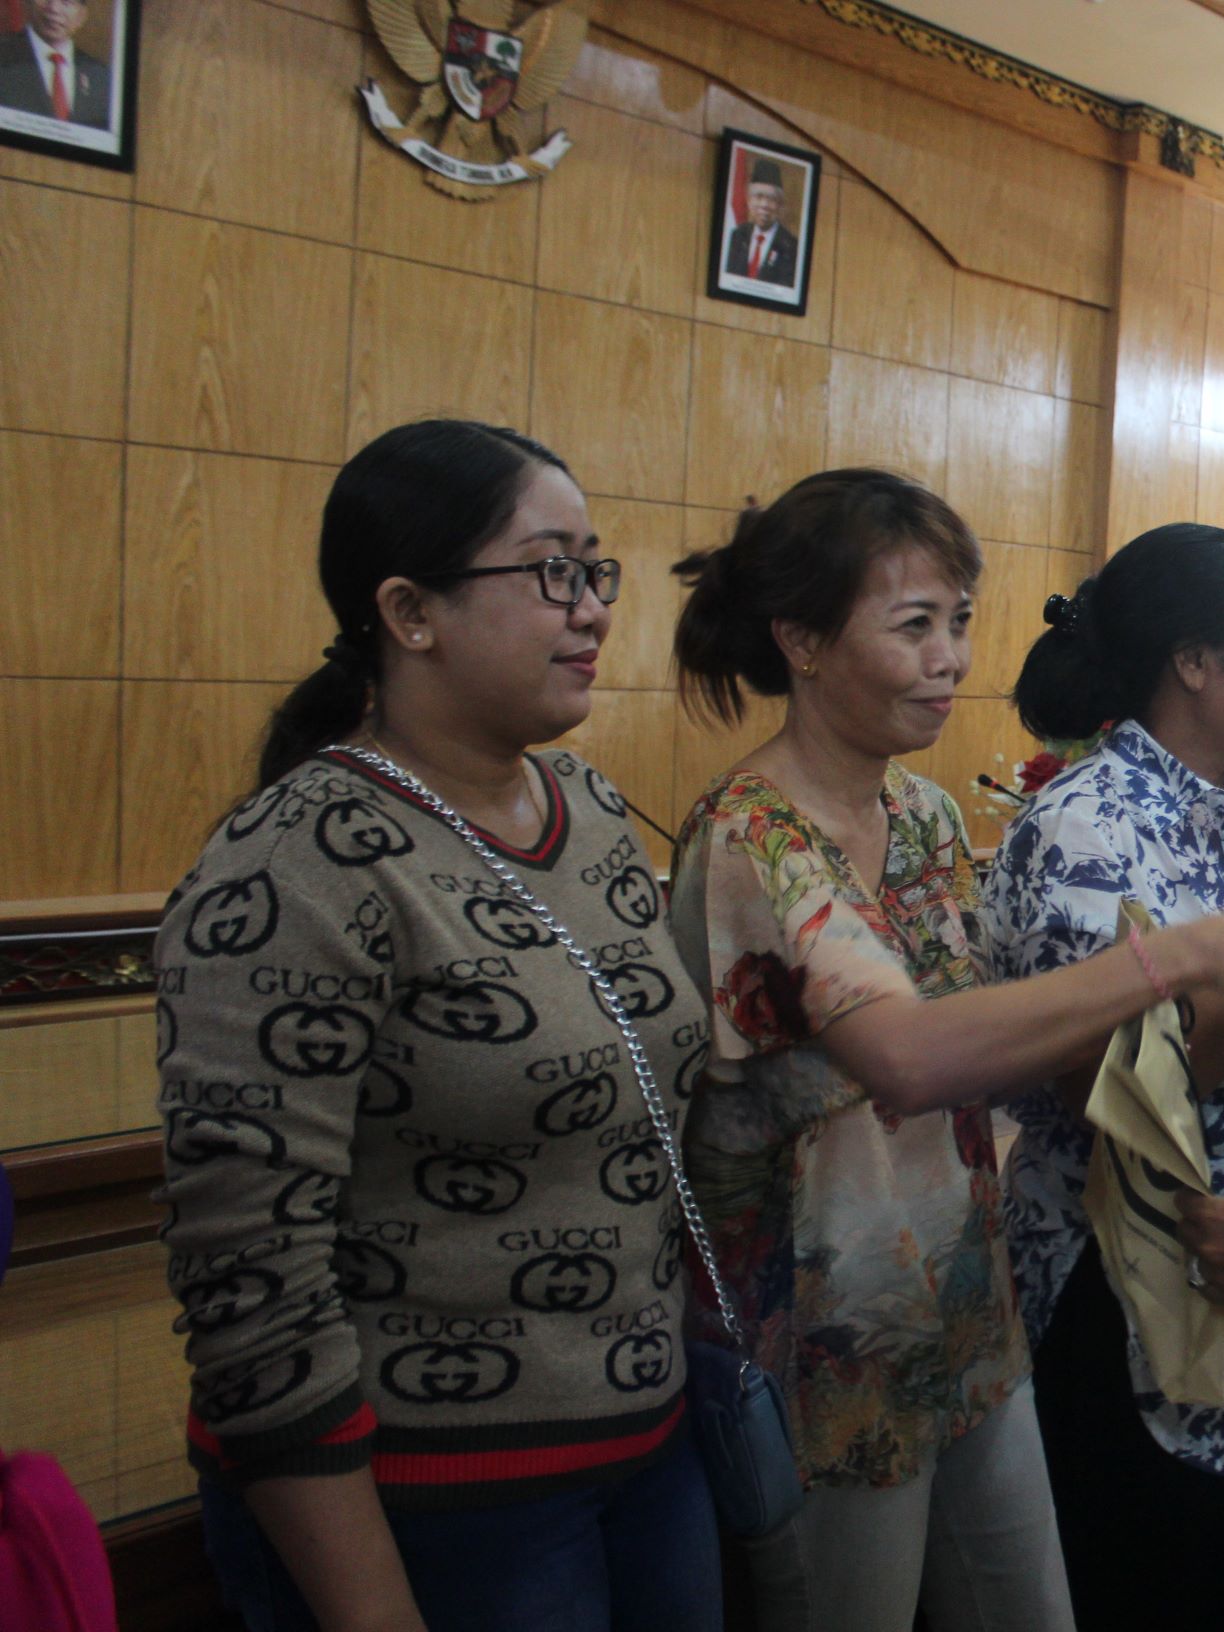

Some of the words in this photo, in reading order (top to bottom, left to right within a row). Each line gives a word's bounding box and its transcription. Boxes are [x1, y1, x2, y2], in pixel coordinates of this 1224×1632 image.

[580, 834, 637, 886] GUCCI
[250, 966, 387, 1001] GUCCI
[525, 1043, 620, 1083] GUCCI
[498, 1226, 622, 1251] GUCCI
[378, 1312, 527, 1340] GUCCI
[590, 1299, 670, 1337] GUCCI
